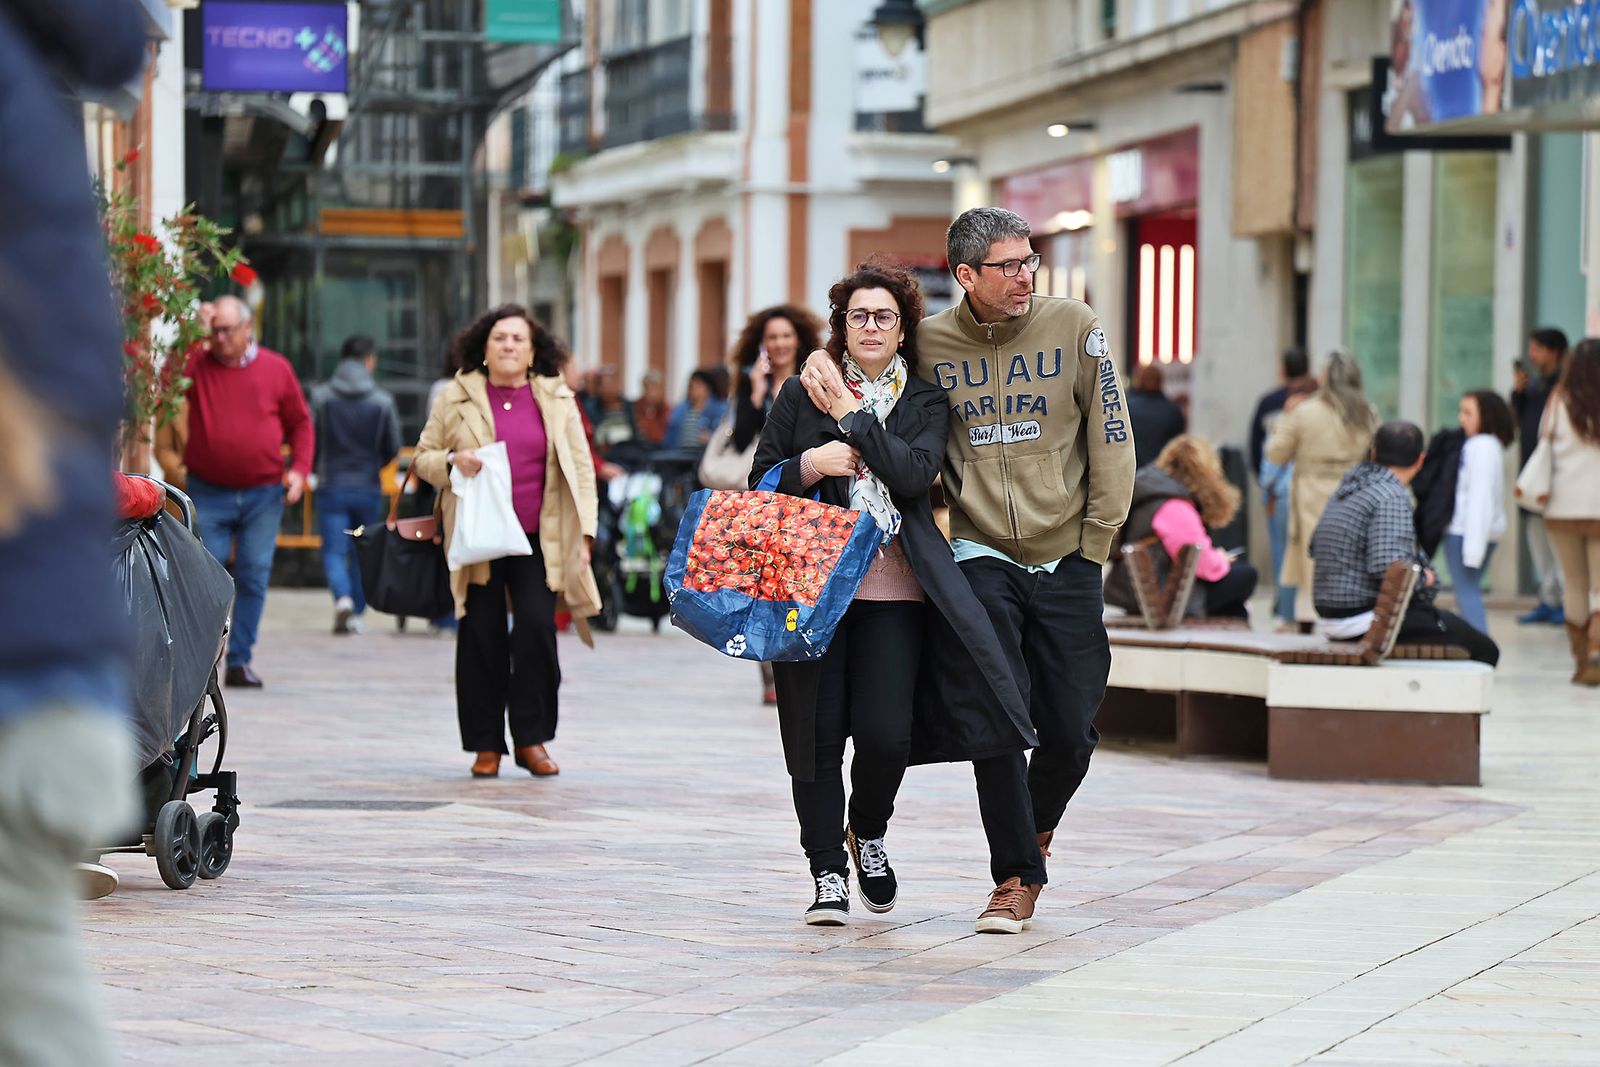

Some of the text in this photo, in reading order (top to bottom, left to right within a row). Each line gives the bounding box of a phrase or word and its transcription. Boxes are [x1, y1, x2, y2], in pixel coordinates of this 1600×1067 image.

[206, 25, 294, 49] TECNO
[1099, 359, 1128, 444] SINCE-02
[971, 422, 1039, 442] Surf Wear
